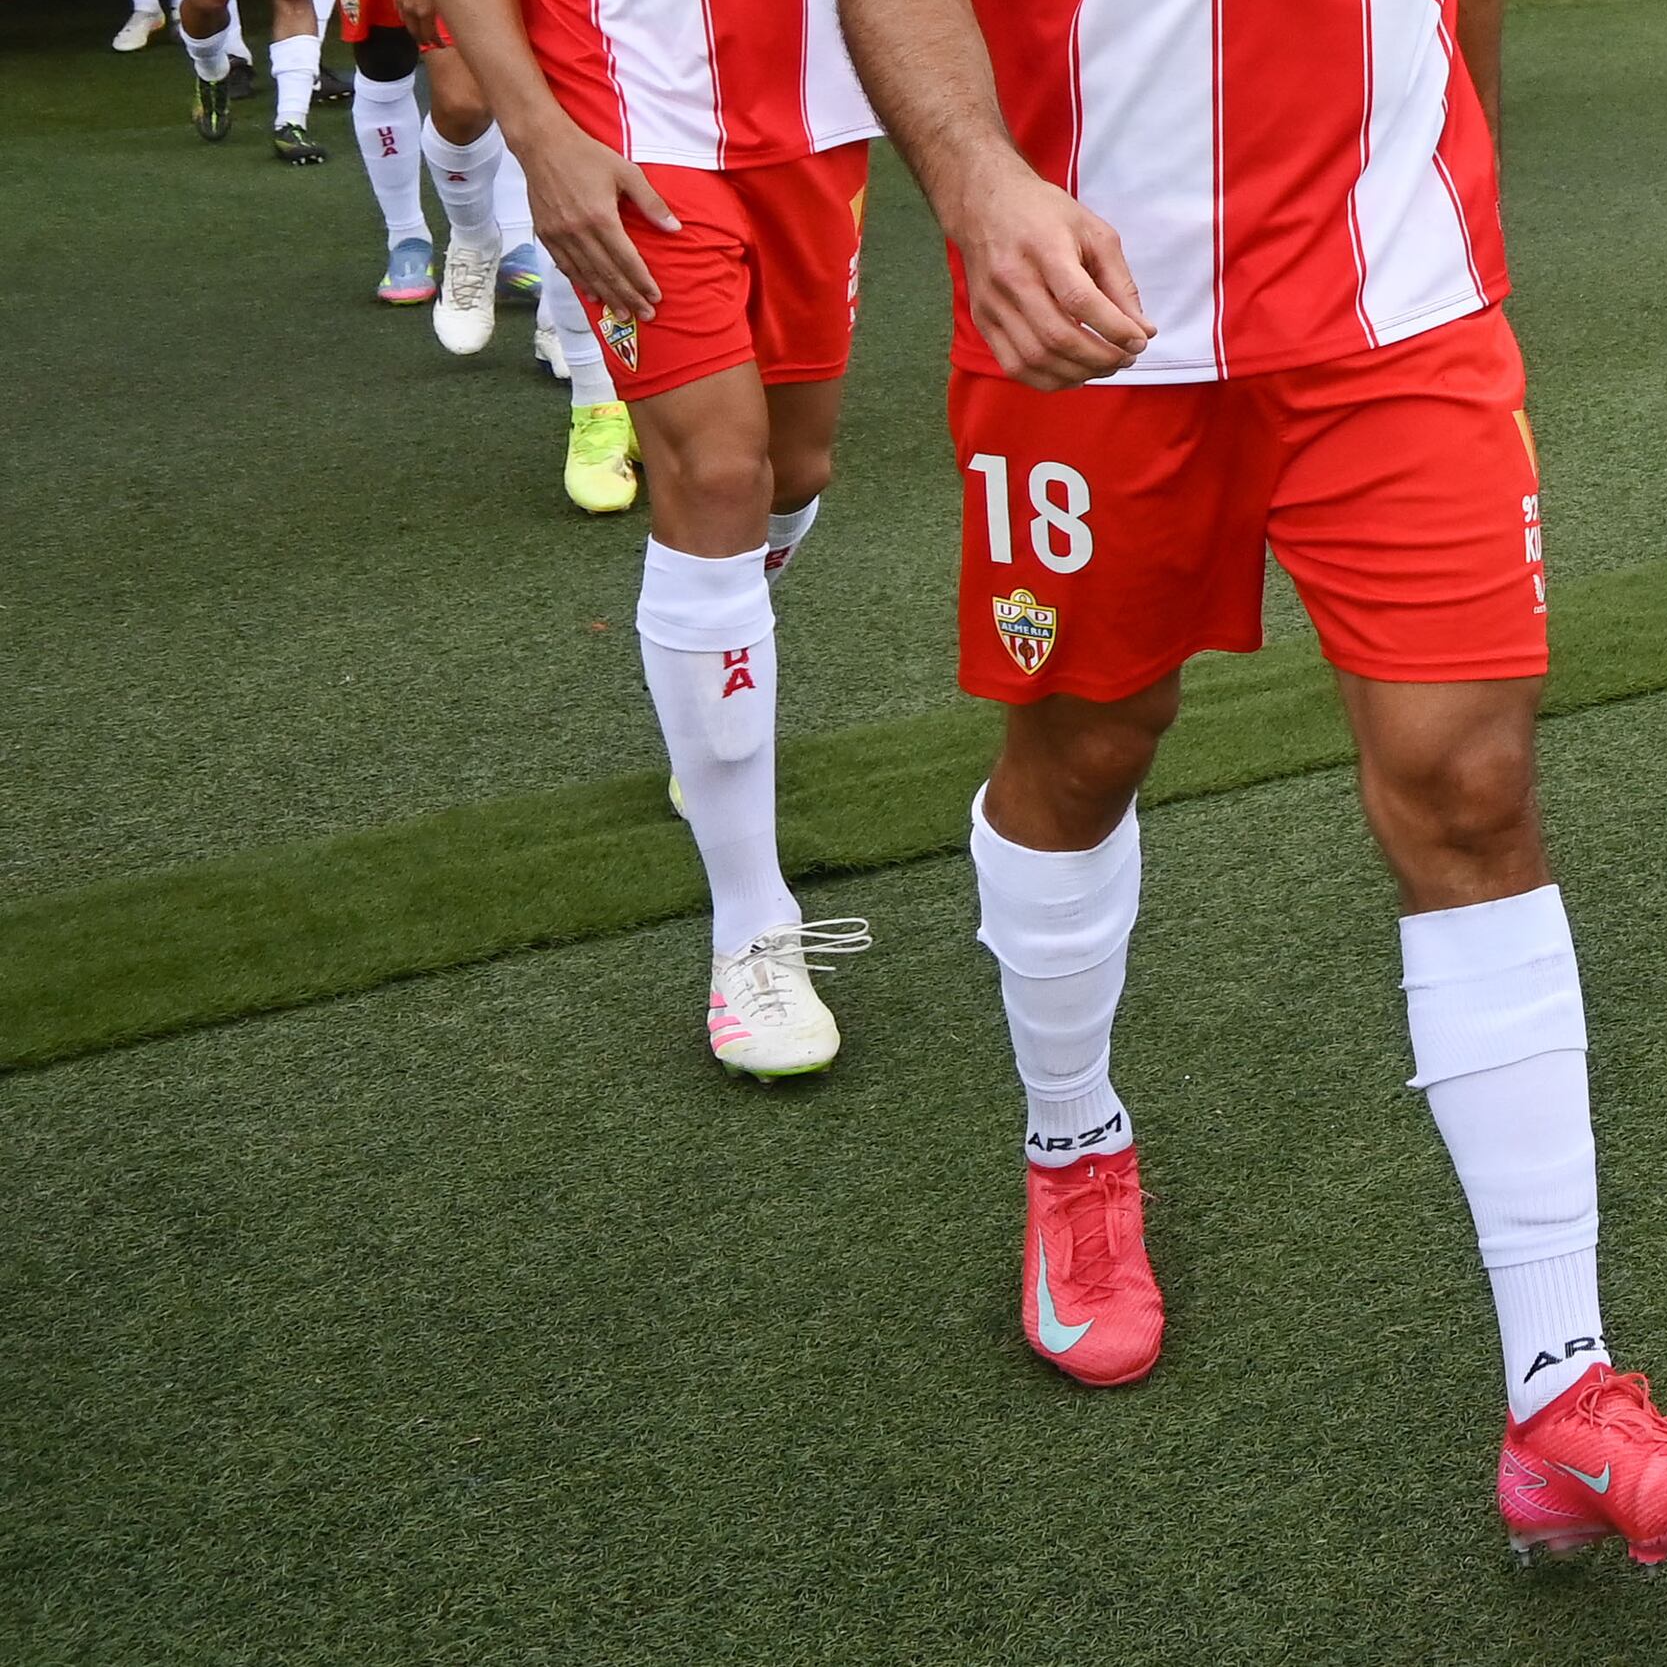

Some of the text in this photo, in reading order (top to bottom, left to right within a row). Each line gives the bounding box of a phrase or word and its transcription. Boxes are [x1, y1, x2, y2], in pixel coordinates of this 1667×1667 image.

[967, 452, 1093, 574] 18
[1000, 603, 1049, 623] U D
[1001, 621, 1052, 639] ALMERIA
[720, 647, 757, 699] DA
[1523, 1334, 1607, 1384] AR
